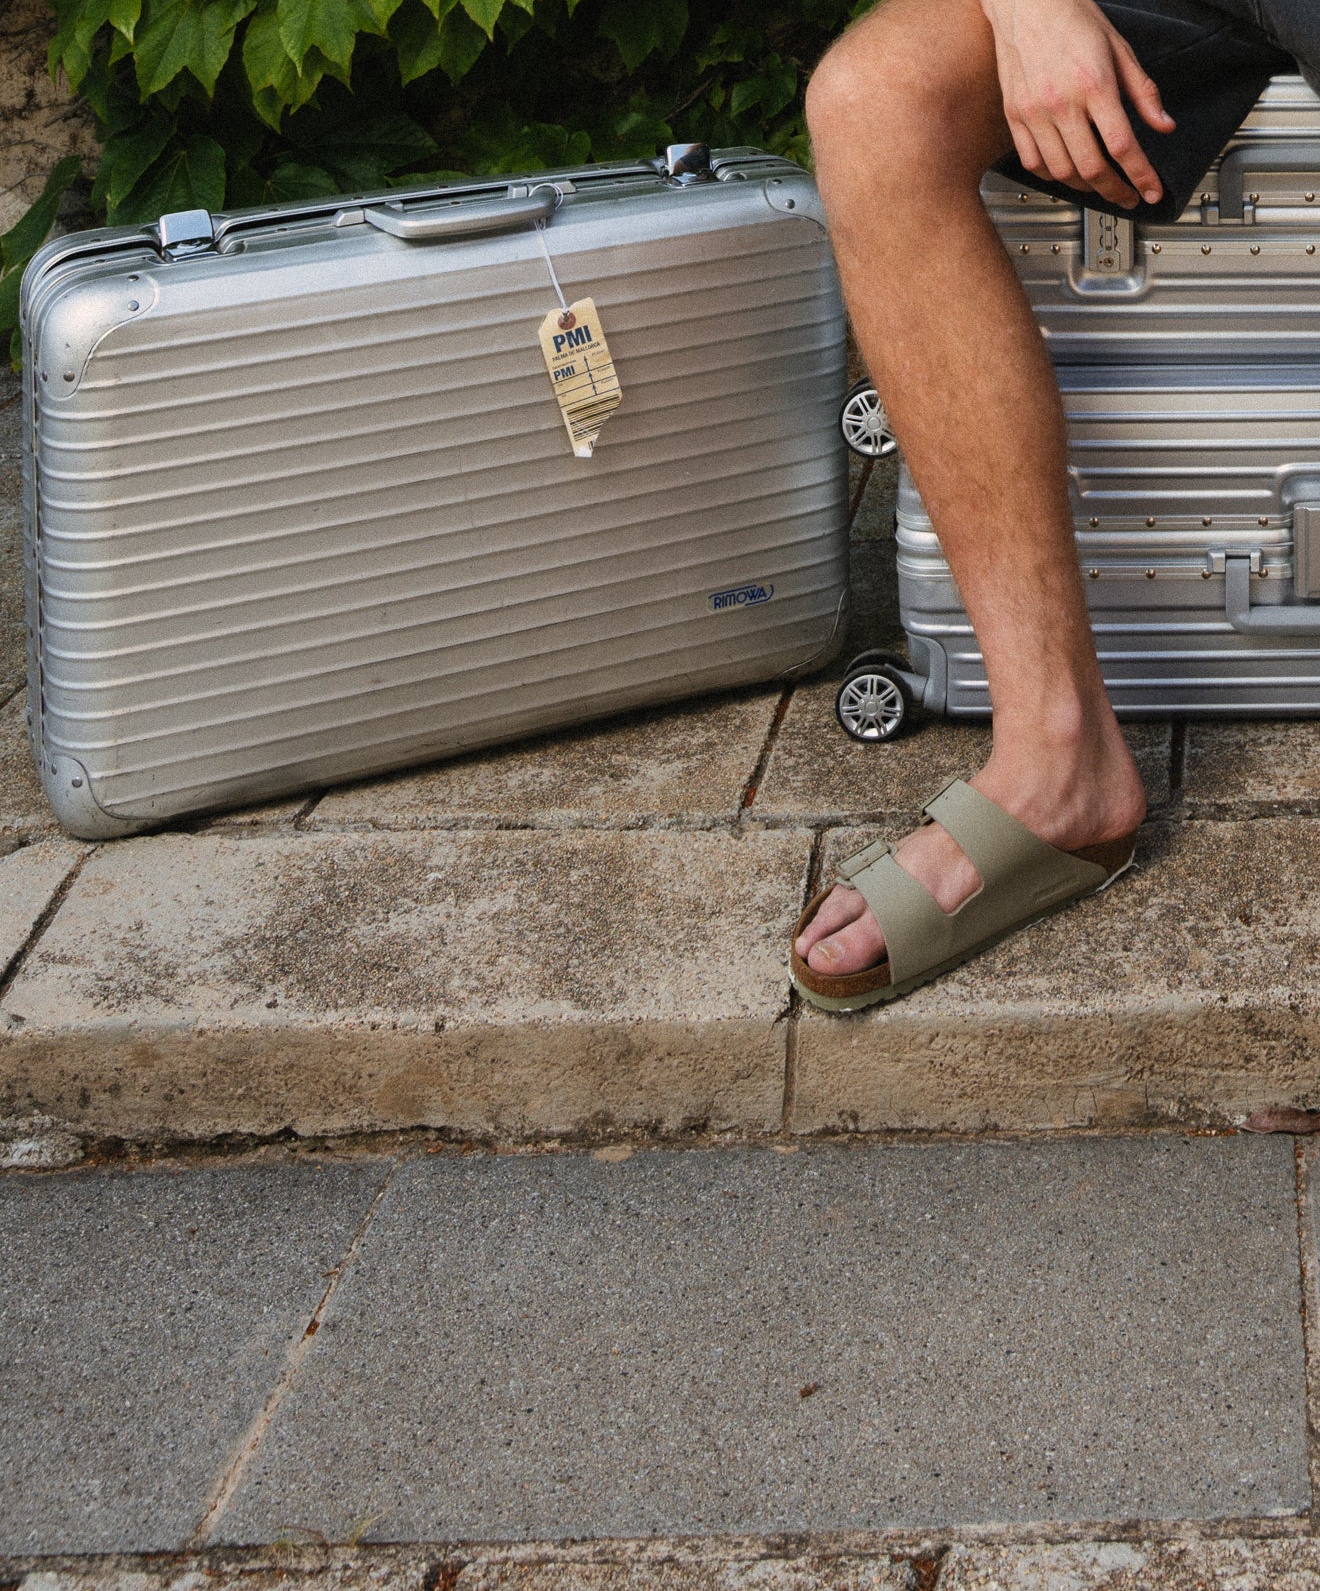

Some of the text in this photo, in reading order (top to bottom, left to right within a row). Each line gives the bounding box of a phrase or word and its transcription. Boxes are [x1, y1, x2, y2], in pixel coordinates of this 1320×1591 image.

[553, 325, 593, 353] PMI
[552, 352, 568, 362] PALMA
[576, 341, 601, 354] MALLORCA
[553, 365, 576, 381] PMI
[714, 586, 767, 609] RIMOWA
